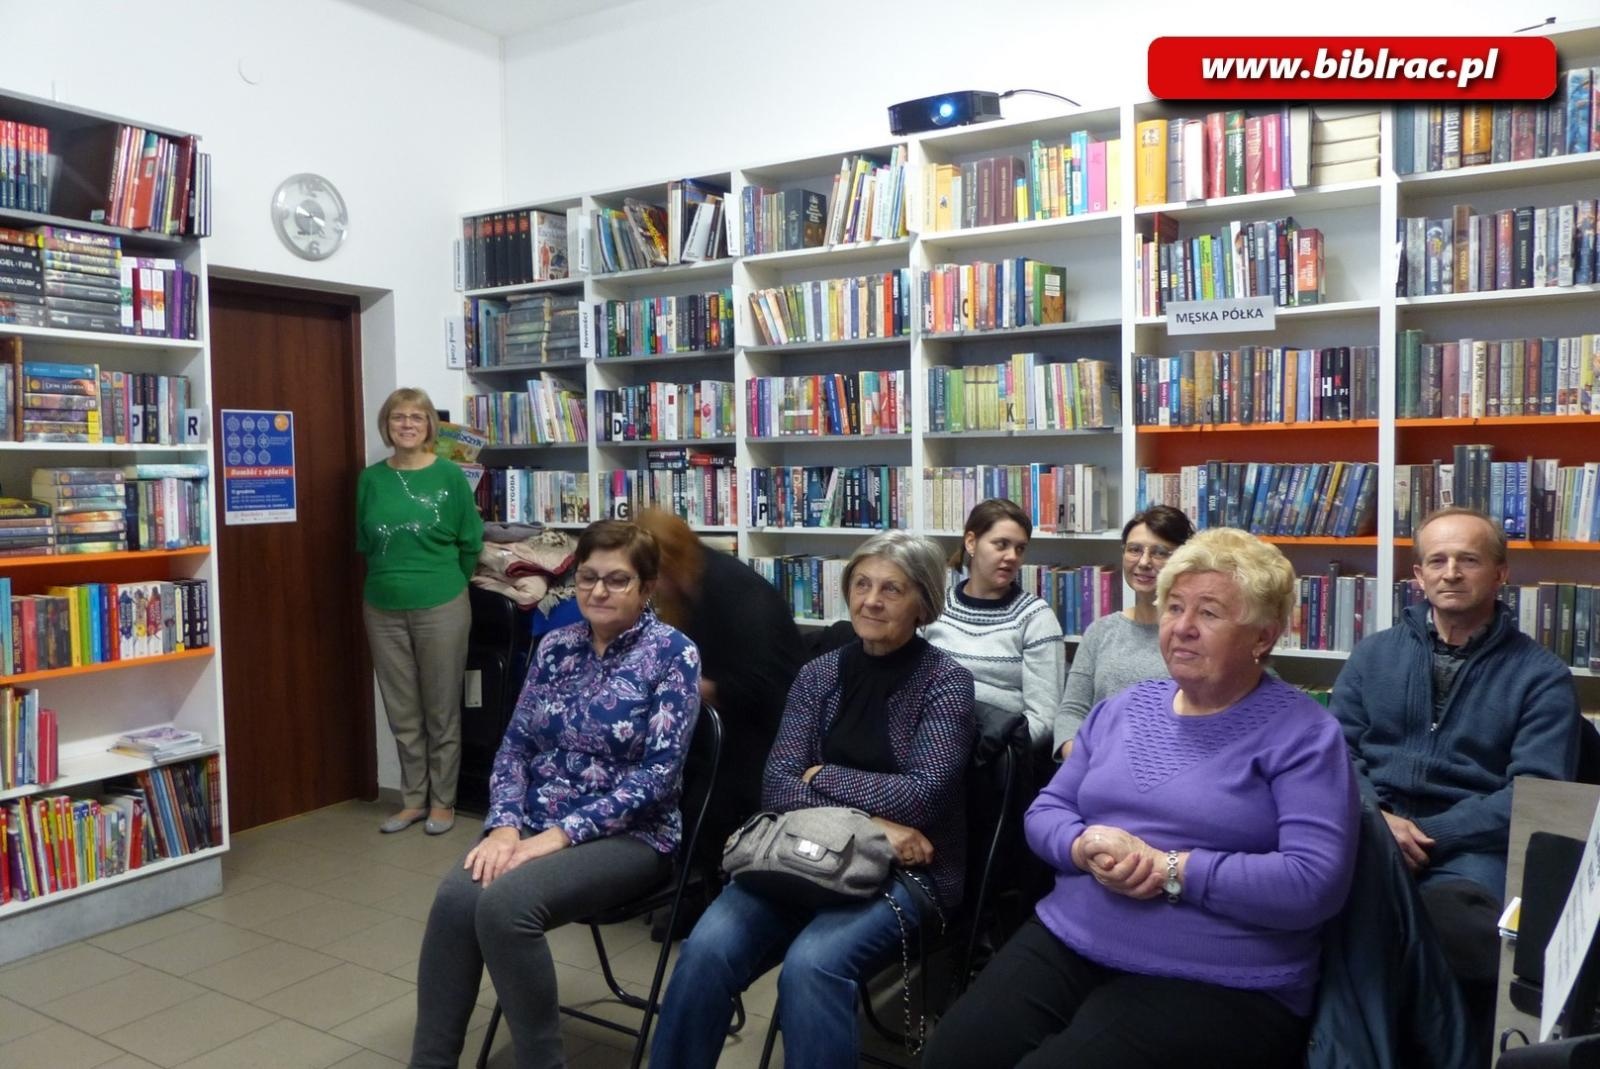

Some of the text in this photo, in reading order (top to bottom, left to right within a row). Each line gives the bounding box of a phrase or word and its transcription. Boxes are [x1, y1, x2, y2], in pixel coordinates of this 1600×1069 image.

[1176, 307, 1264, 324] MĘSKA PÓŁKA
[1006, 403, 1015, 422] K
[187, 416, 198, 436] R
[613, 419, 622, 435] D
[759, 503, 767, 520] P
